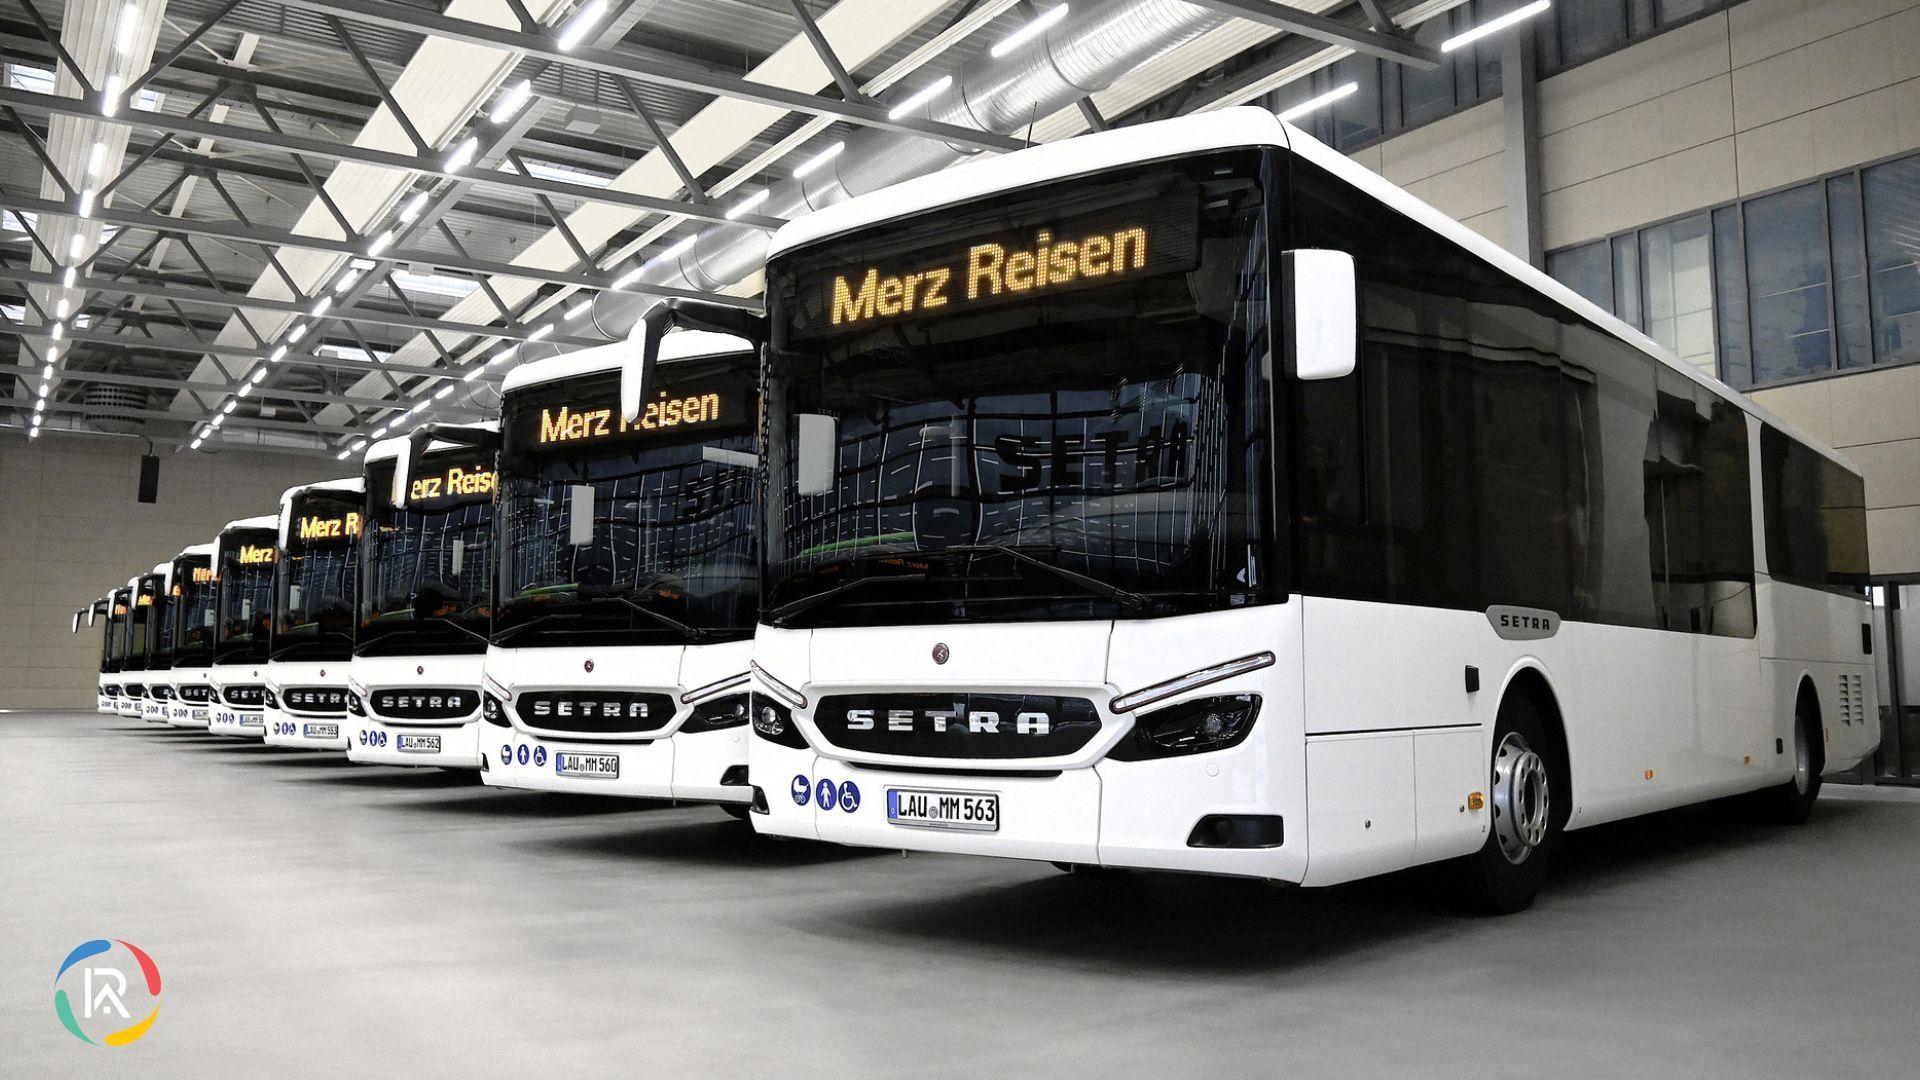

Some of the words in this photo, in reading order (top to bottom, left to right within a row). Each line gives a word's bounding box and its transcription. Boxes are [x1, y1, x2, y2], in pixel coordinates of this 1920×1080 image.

[832, 267, 950, 325] Merz
[966, 227, 1146, 300] Reisen
[539, 405, 611, 443] Merz
[410, 477, 442, 500] erz
[300, 515, 342, 539] Merz
[240, 544, 274, 564] Merz
[1500, 614, 1550, 631] SETRA
[381, 696, 461, 708] SETRA
[533, 700, 649, 718] SETRA
[847, 709, 1051, 736] SETRA
[402, 737, 413, 748] LAU
[562, 755, 579, 771] LAU
[585, 757, 597, 772] MM
[599, 757, 617, 773] 560
[898, 794, 928, 818] LAU
[939, 796, 960, 820] MM
[963, 798, 996, 822] 563
